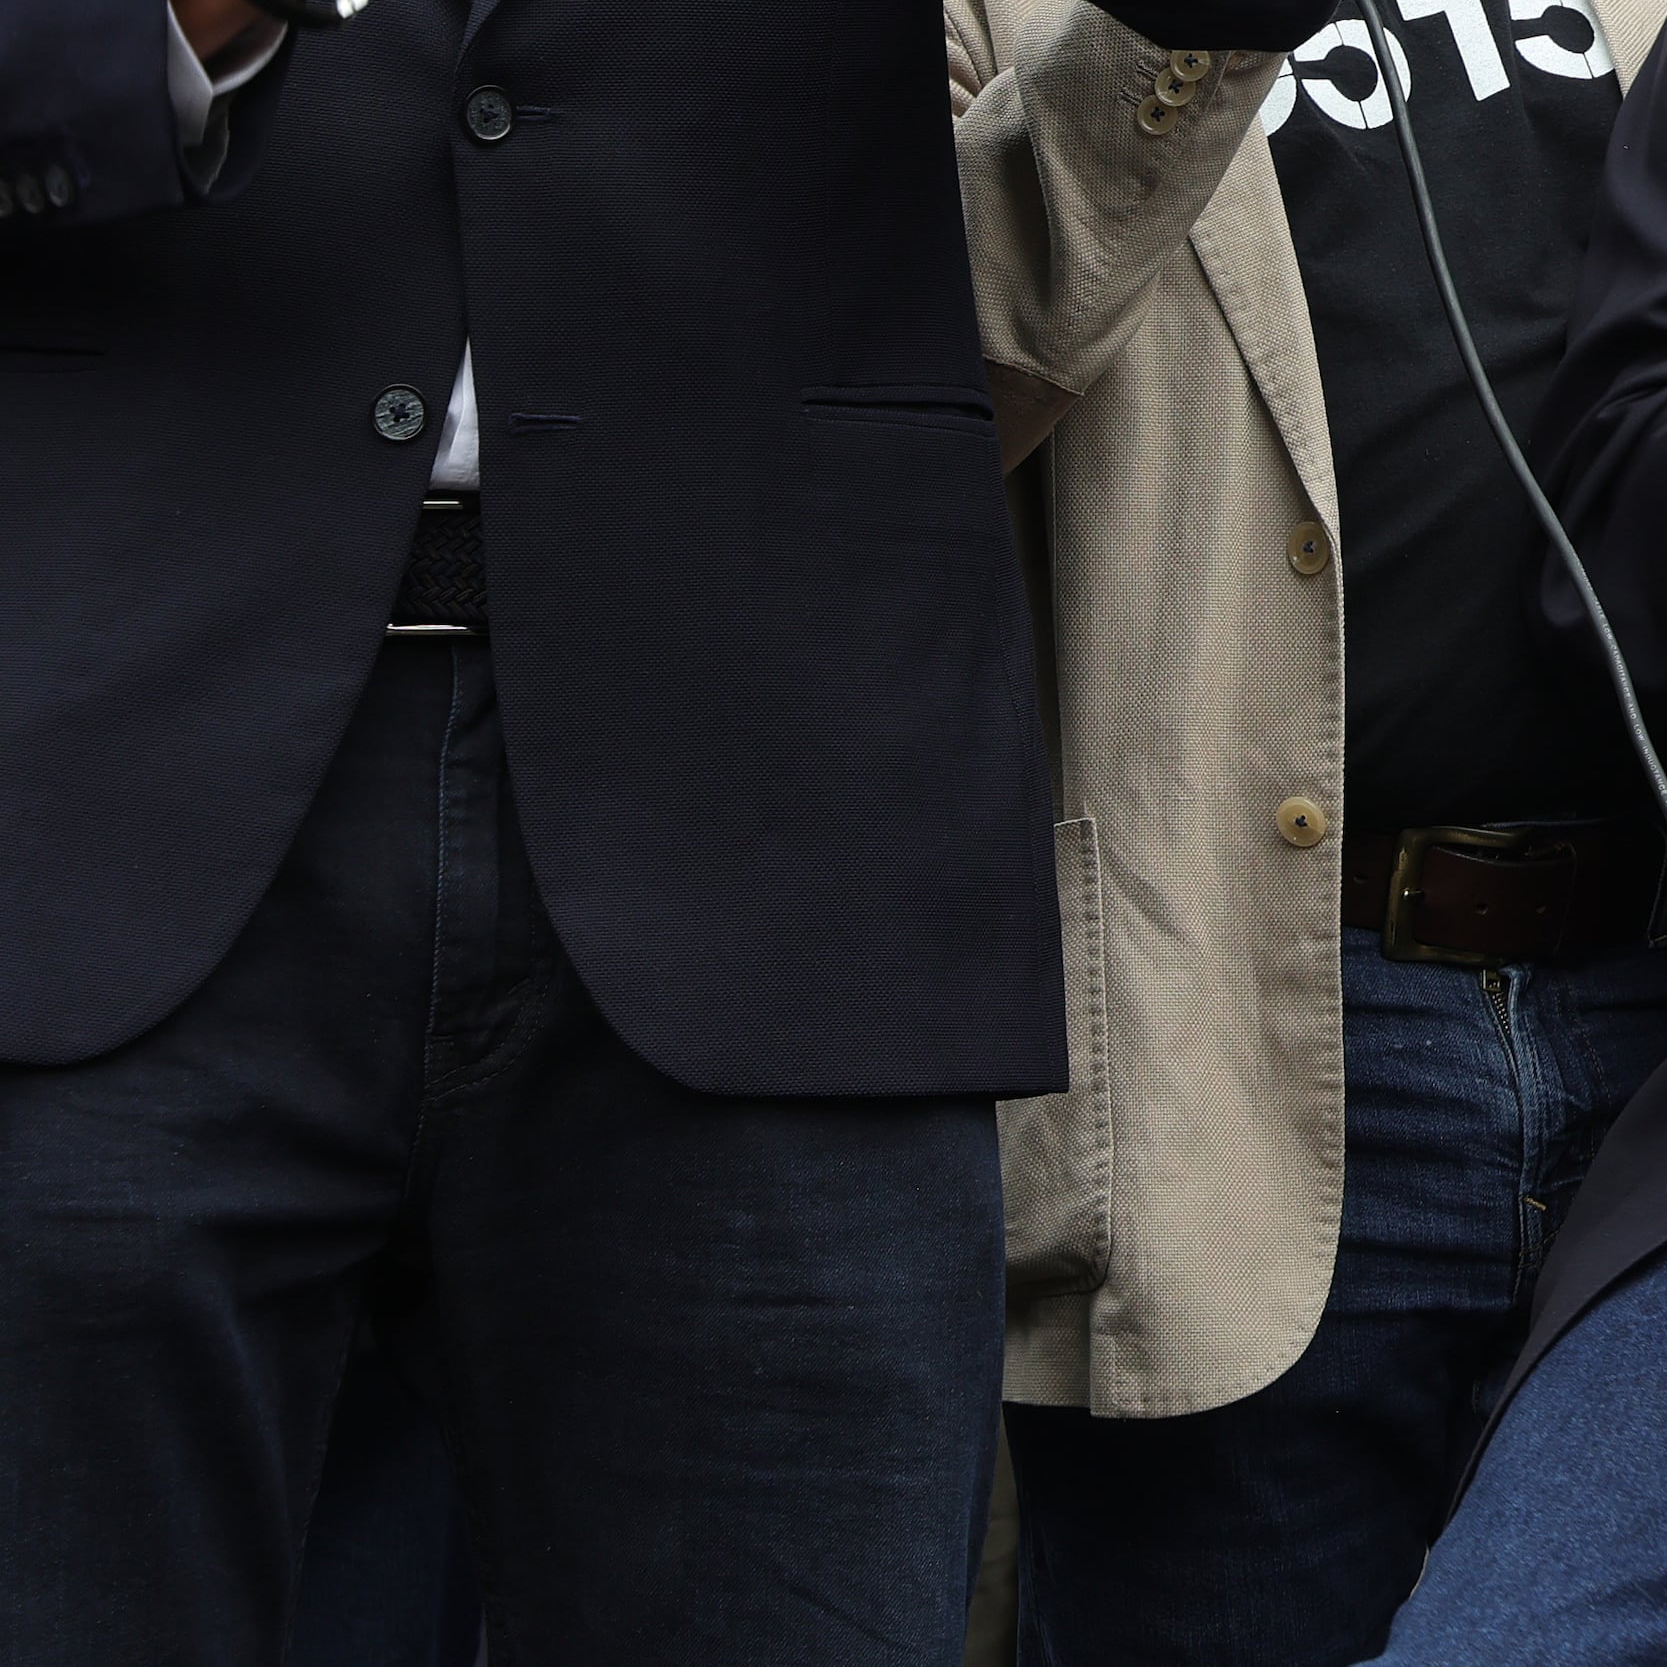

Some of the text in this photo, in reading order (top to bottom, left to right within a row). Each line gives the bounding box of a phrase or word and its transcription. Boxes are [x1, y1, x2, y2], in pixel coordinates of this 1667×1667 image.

[1602, 623, 1613, 640] LOW
[1610, 644, 1631, 697] CAPACITANCE
[1628, 703, 1637, 720] AND
[1633, 723, 1645, 741] LOW
[1642, 745, 1667, 795] INDUCTANCE
